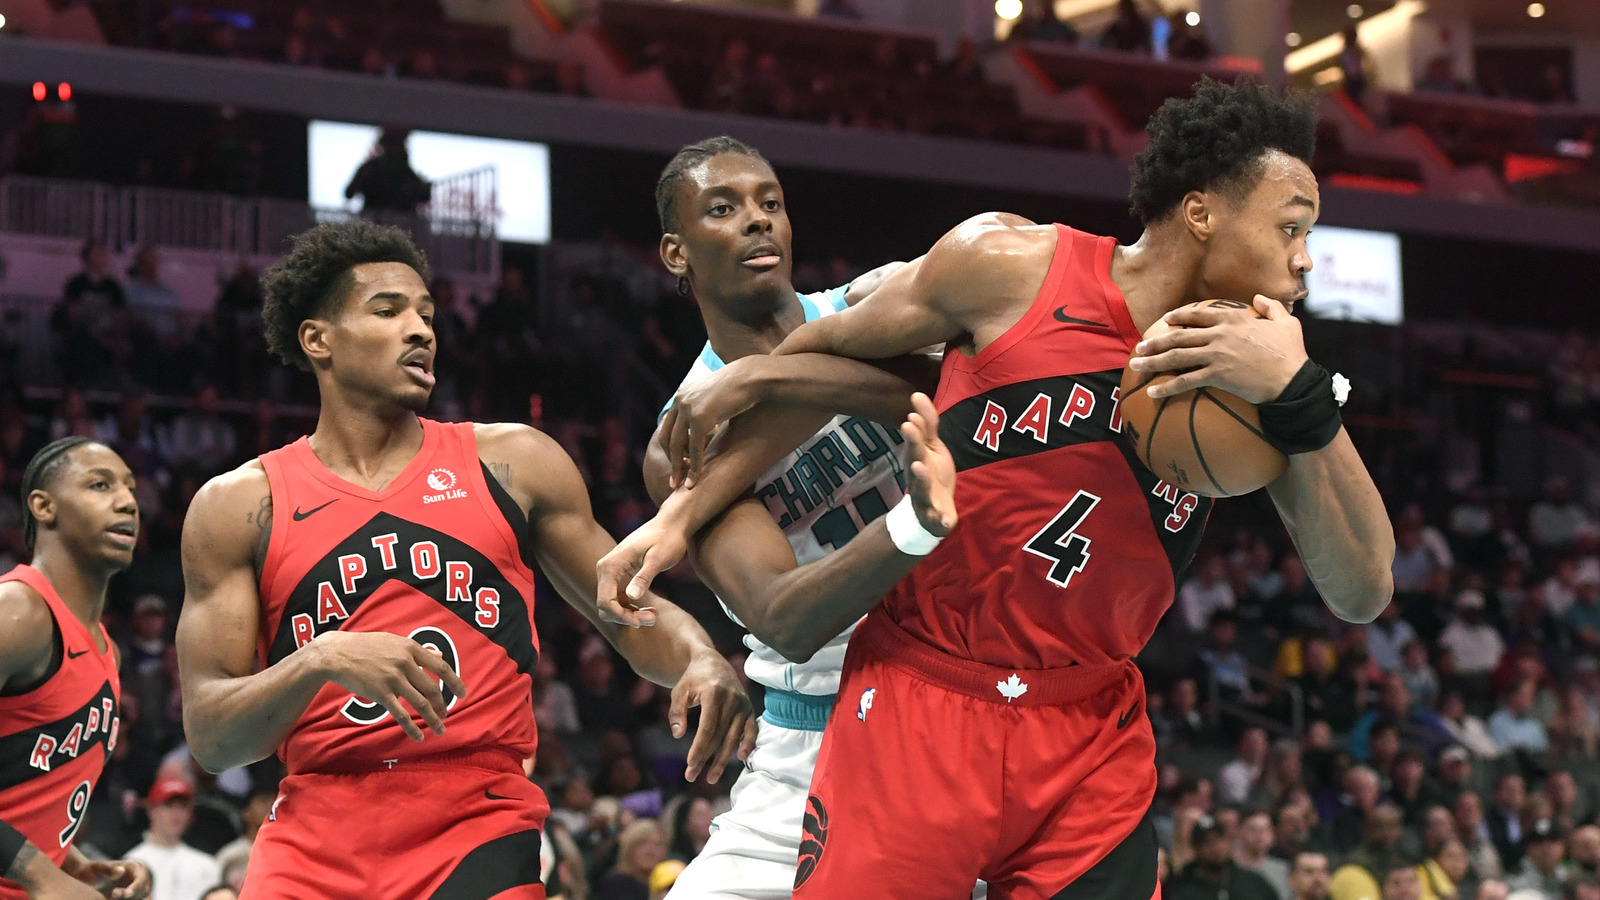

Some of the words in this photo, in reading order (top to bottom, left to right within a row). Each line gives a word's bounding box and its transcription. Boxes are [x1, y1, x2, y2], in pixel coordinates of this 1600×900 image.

[423, 495, 445, 504] Sun
[446, 489, 467, 499] Life
[1022, 489, 1101, 588] 4
[292, 533, 499, 650] RAPTORS
[59, 780, 91, 848] 9
